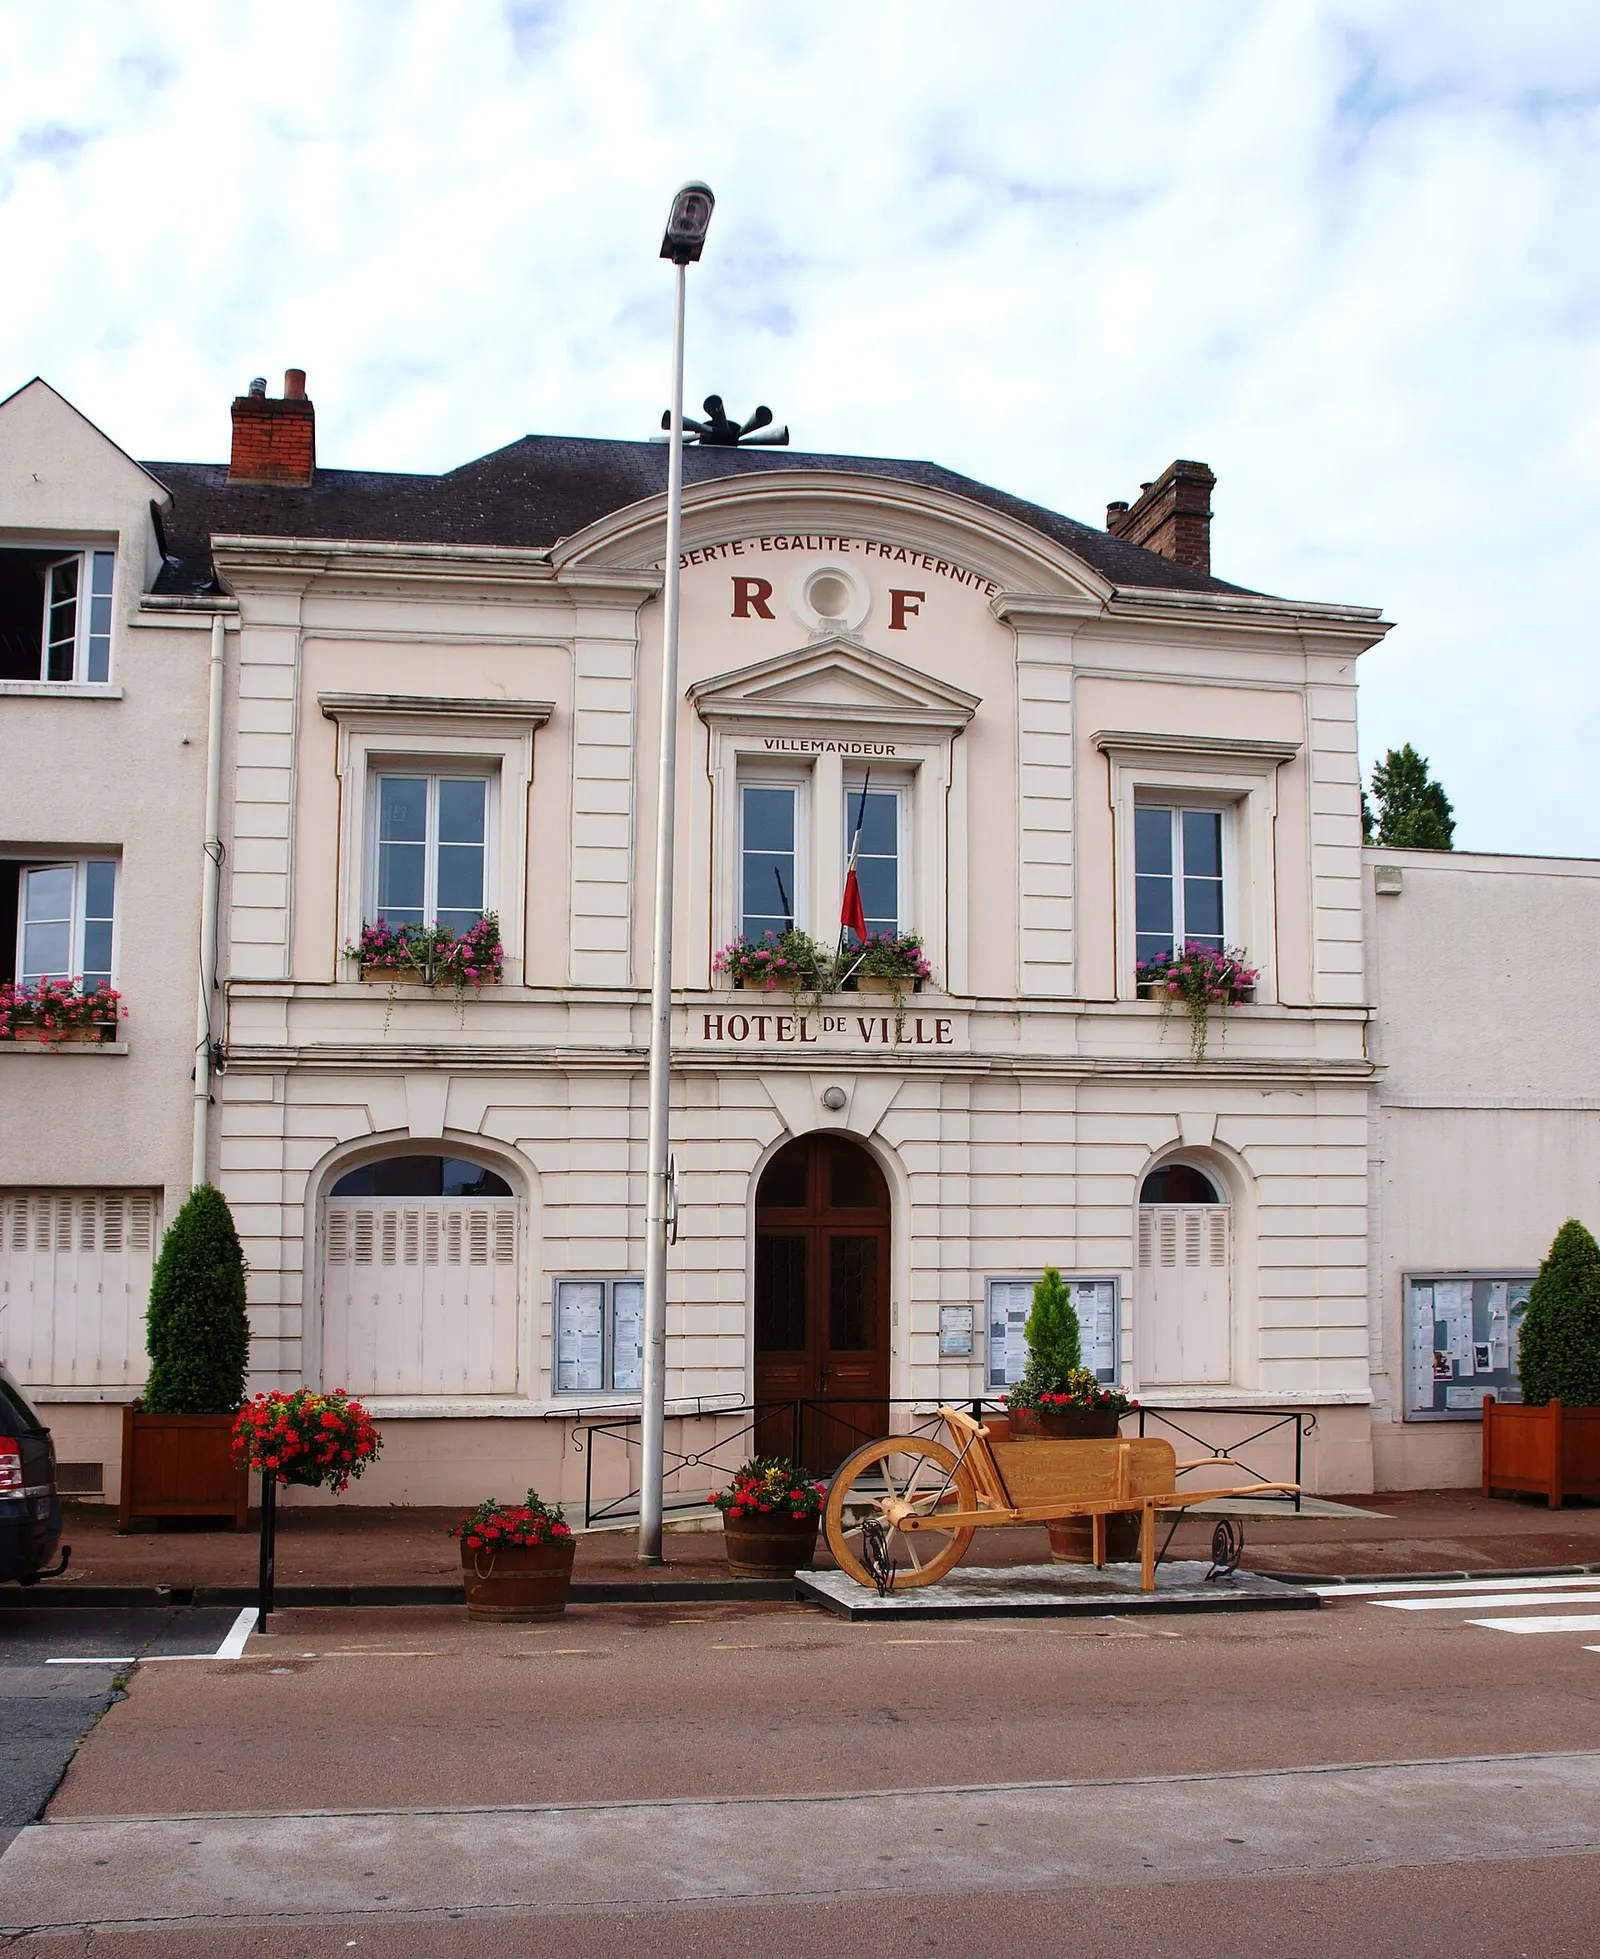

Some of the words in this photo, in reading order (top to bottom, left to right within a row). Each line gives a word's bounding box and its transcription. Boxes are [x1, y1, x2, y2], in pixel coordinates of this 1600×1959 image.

[655, 540, 745, 570] BERTE
[760, 535, 850, 552] EGALITE
[865, 541, 998, 597] FRATERNITE
[730, 575, 776, 620] R
[888, 588, 926, 630] F
[764, 739, 895, 755] VILLEMANDEUR
[703, 1014, 818, 1043] HOTEL
[823, 1016, 847, 1032] DE
